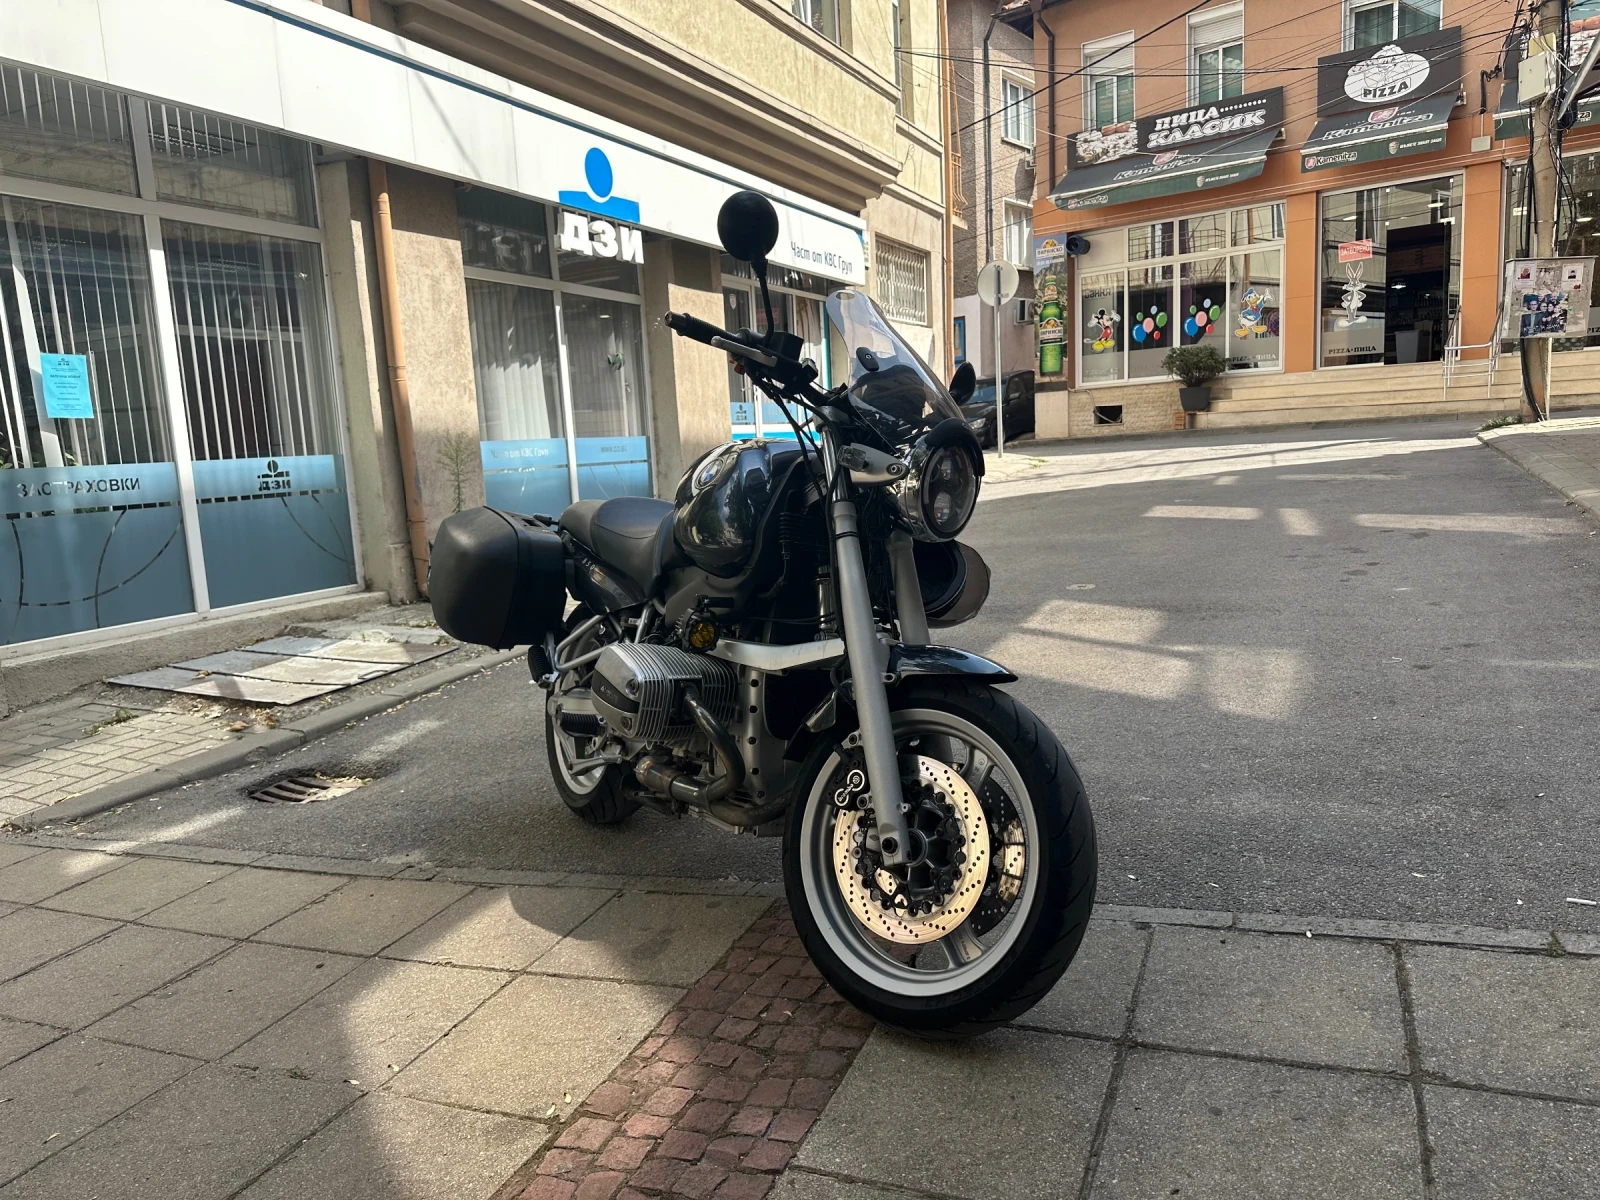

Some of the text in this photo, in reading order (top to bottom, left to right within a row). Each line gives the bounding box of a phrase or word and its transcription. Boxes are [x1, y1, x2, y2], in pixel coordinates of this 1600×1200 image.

[1363, 81, 1409, 98] PIZZA
[1147, 109, 1266, 148] КЛАСИК
[1154, 106, 1220, 131] ПИЦА
[1317, 151, 1357, 166] Kamenitza
[554, 212, 644, 264] ДЗИ
[790, 241, 853, 275] Част от КВС Груп
[17, 477, 140, 498] ЗАСТРАХОВКИ
[258, 479, 292, 491] ДЗИ
